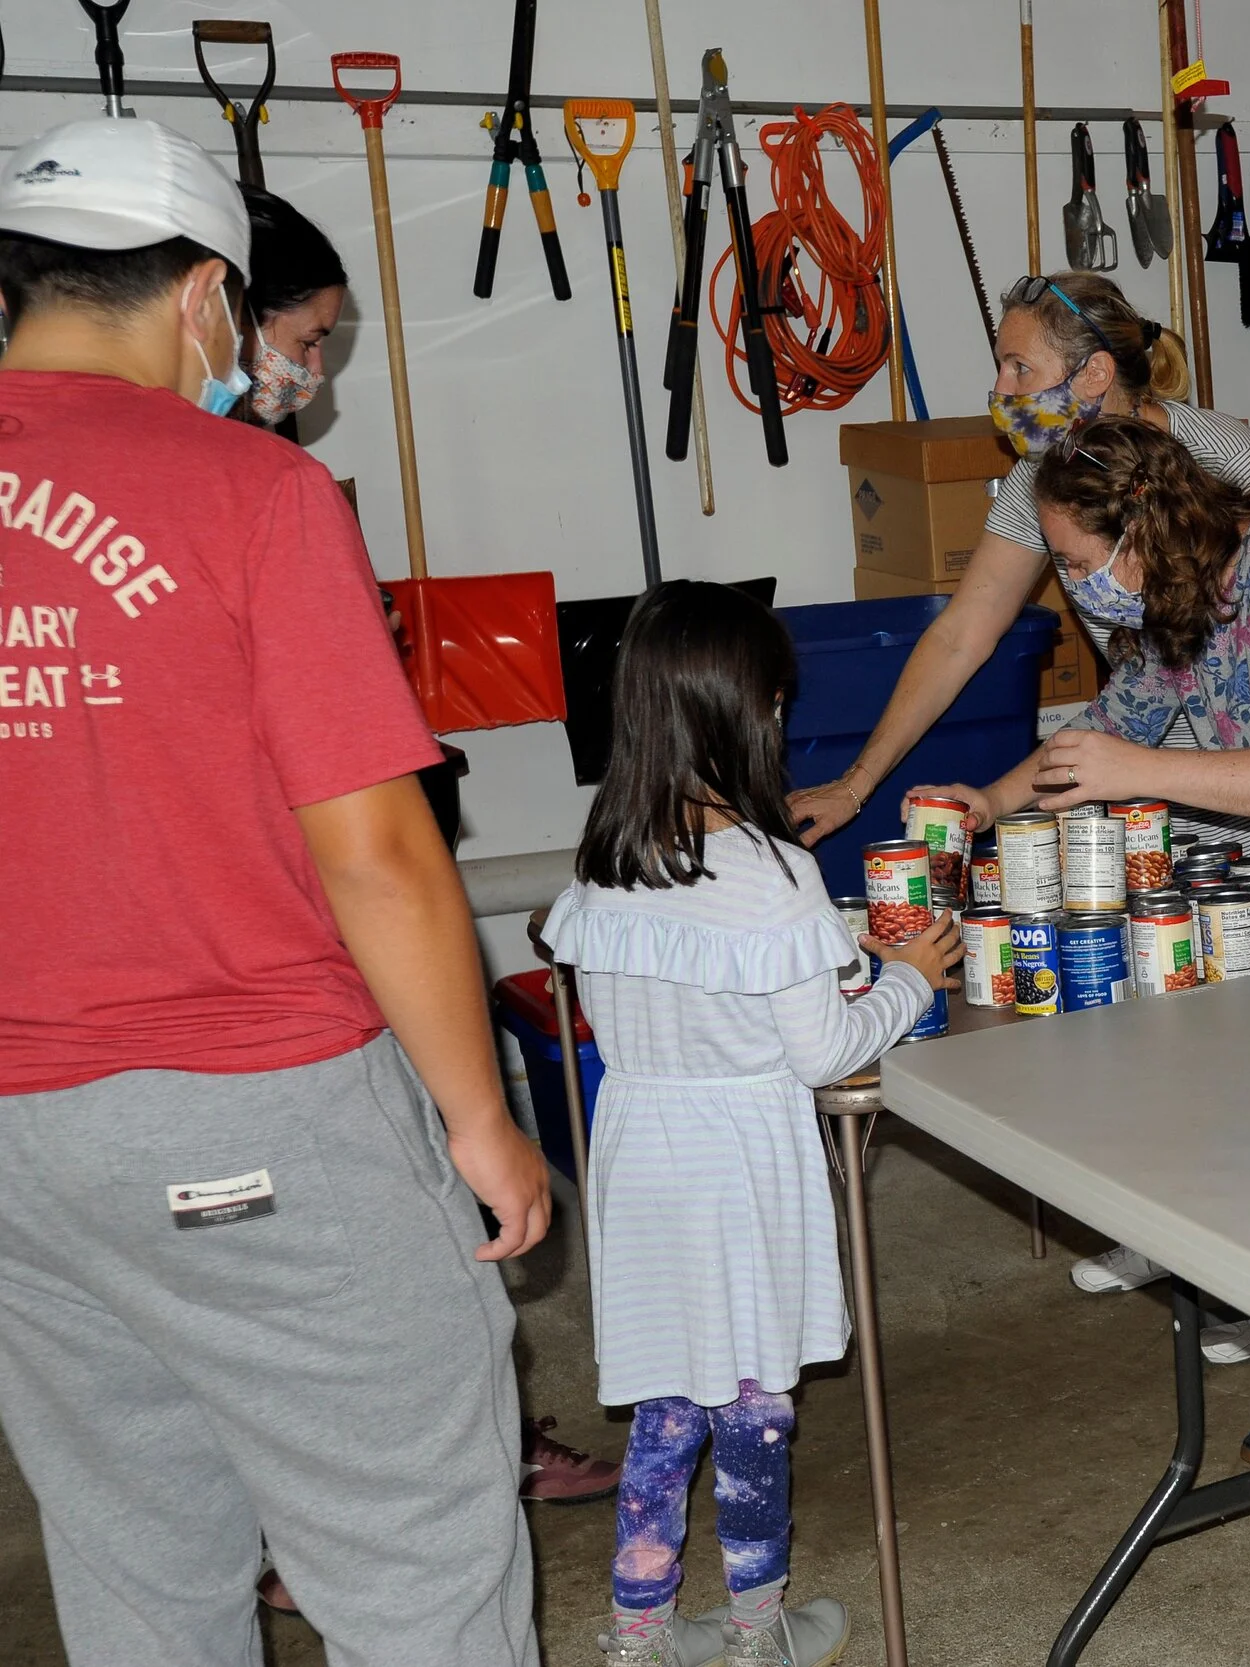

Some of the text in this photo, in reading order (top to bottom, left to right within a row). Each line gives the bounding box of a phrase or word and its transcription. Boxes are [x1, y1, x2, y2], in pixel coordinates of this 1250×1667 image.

[0, 606, 79, 649] ARY
[1038, 712, 1065, 723] vice.
[1137, 833, 1159, 842] Beans
[877, 882, 900, 892] Beans
